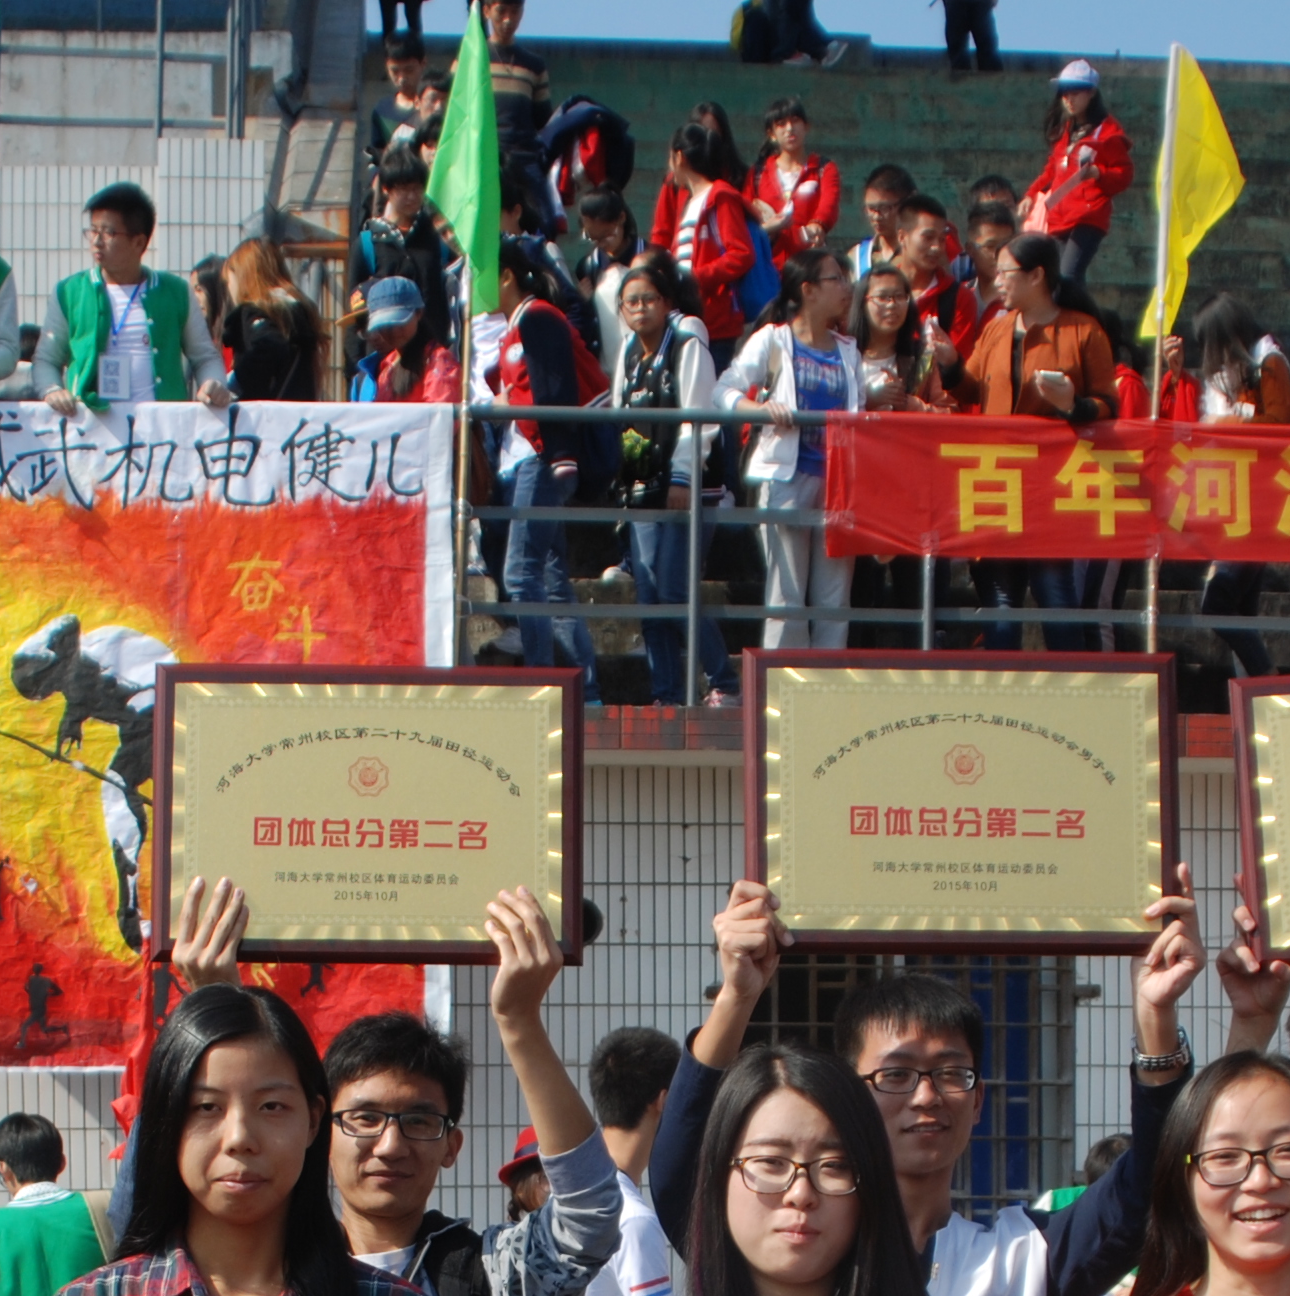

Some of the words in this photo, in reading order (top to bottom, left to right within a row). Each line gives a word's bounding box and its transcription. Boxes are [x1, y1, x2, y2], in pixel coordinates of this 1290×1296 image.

[850, 805, 1085, 839] 团体总分第二名
[253, 817, 488, 849] 团体总分第二名
[873, 861, 1058, 875] 河海大学常州校区体育运动委员会
[274, 871, 459, 885] 河海大学常州校区体育运动委员会
[933, 880, 998, 892] 2015年10月
[334, 890, 398, 902] 2015年10月
